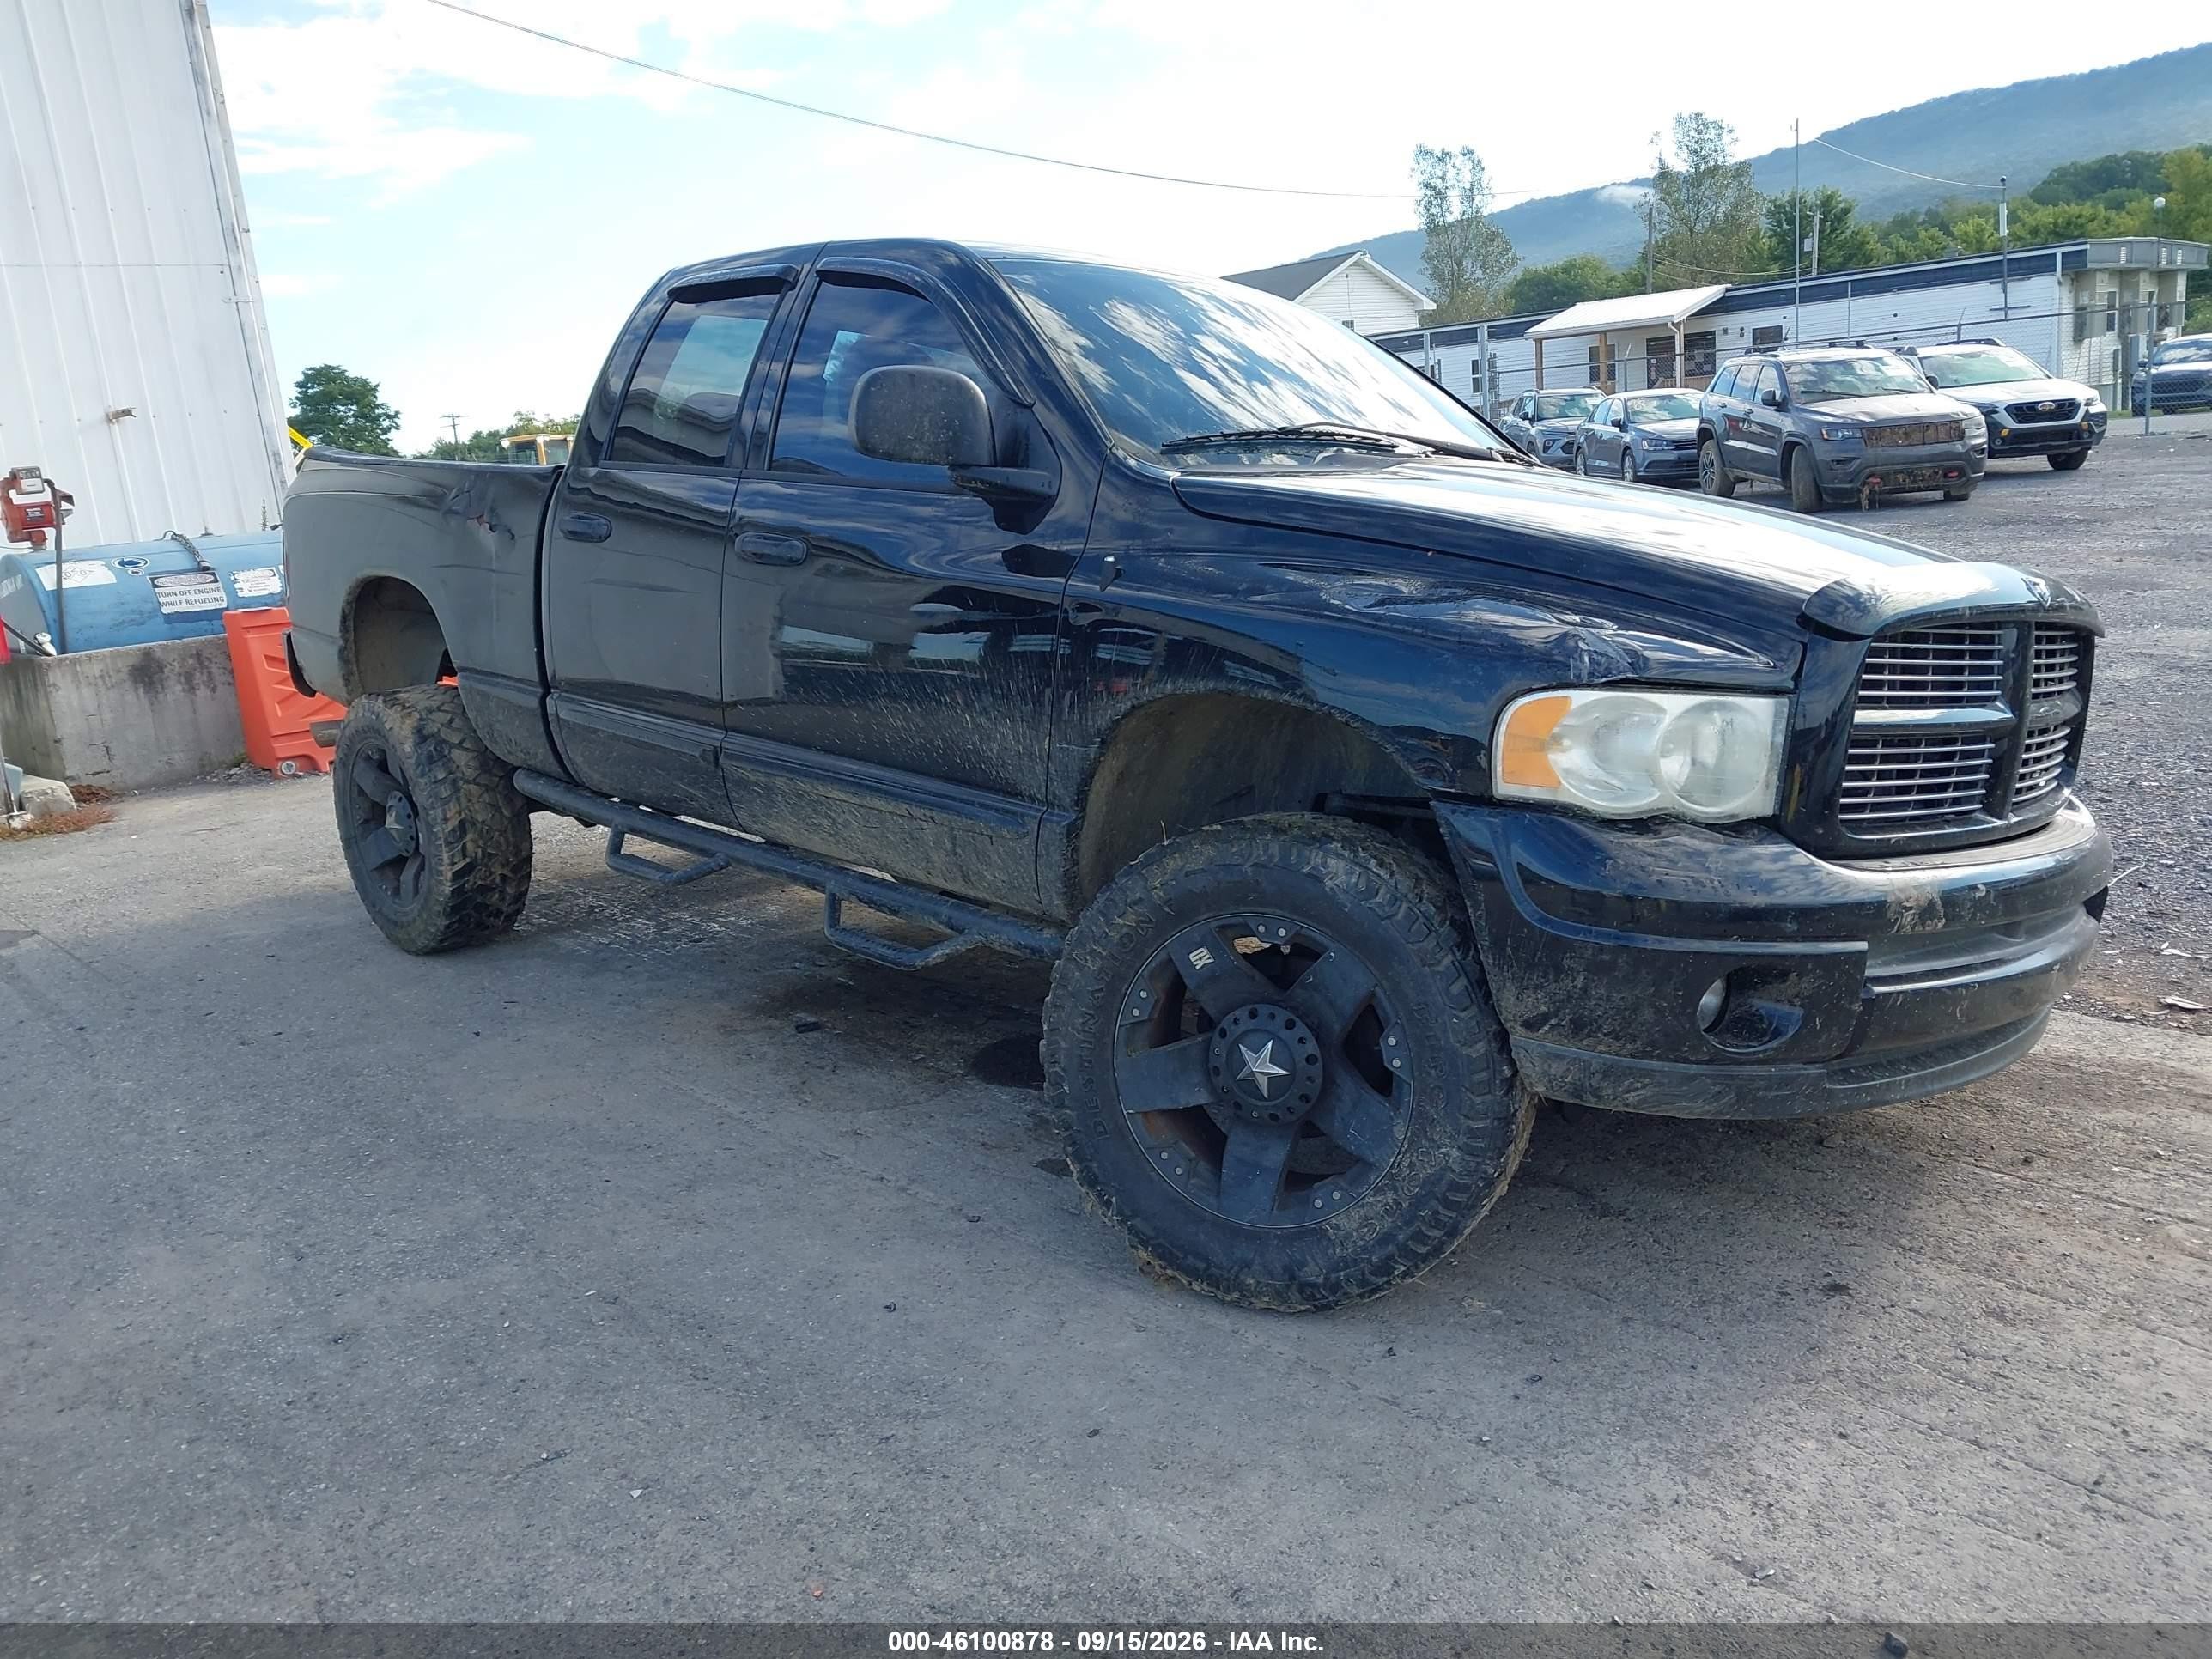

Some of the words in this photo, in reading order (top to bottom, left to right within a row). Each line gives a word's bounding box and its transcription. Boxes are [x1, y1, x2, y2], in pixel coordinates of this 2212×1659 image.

[193, 586, 222, 595] ENGINE
[161, 599, 183, 608] WHILE
[185, 596, 225, 605] REFUELING
